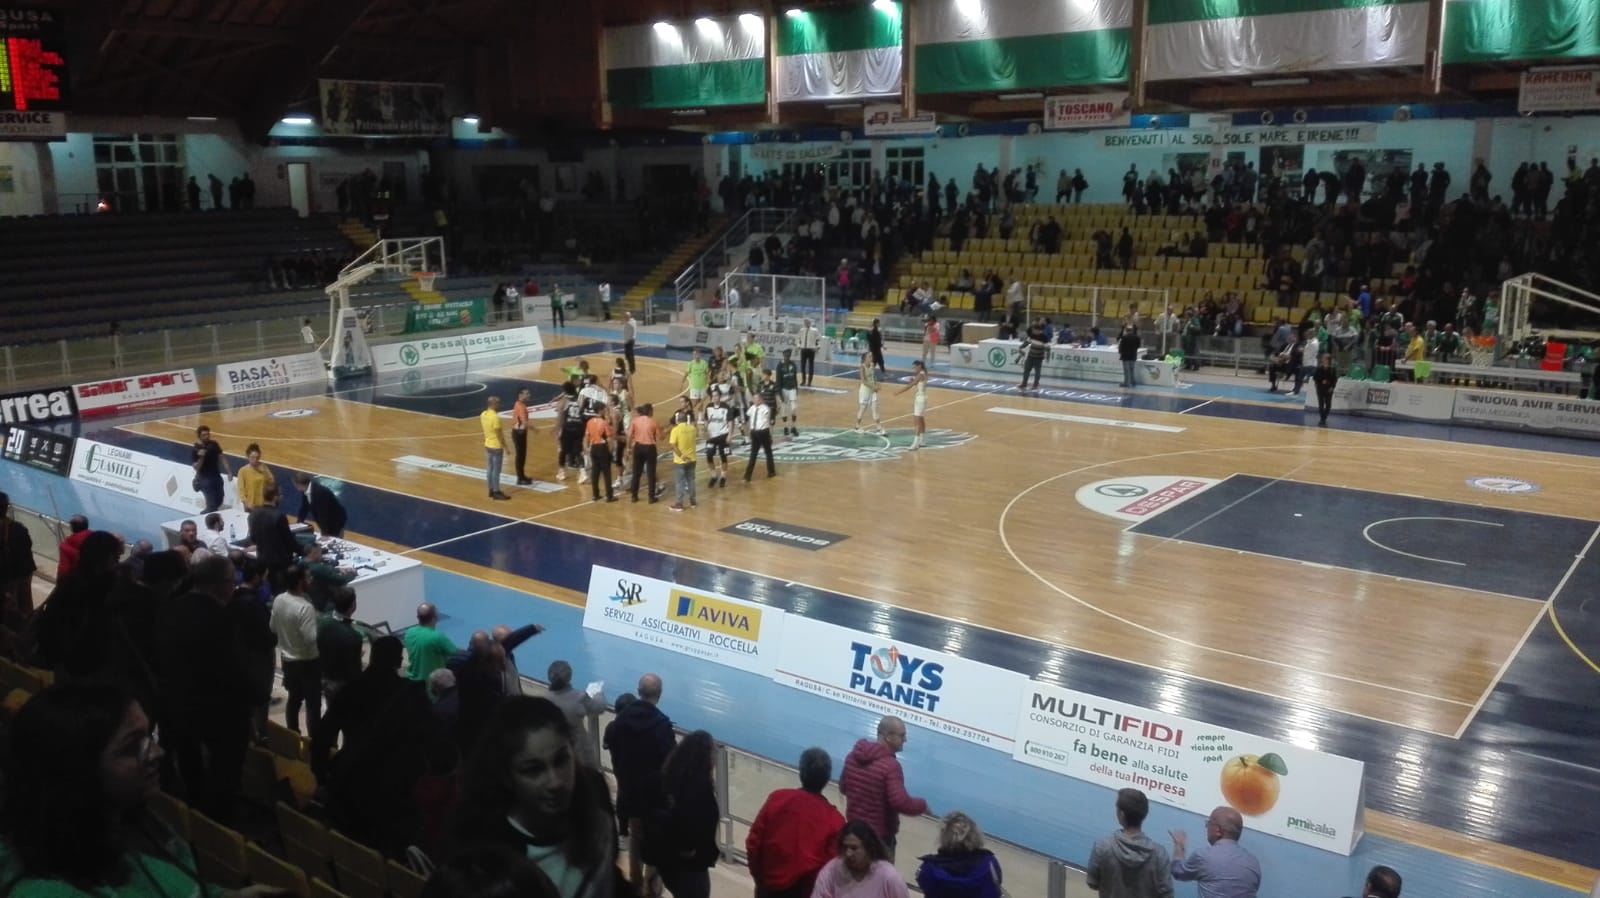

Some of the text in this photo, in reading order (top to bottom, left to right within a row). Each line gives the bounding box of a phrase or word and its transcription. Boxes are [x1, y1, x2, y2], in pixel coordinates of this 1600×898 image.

[1526, 72, 1592, 84] KAMERINA
[1059, 102, 1113, 115] TOSCANO
[1104, 134, 1164, 146] BENVENUTI
[1172, 134, 1184, 145] AL
[422, 334, 506, 351] Passalacqua
[1010, 348, 1099, 364] Placqua
[232, 377, 290, 391] FITNESS CLUB
[1474, 396, 1518, 406] NUOVA
[1522, 398, 1553, 410] AVIR
[1124, 480, 1202, 516] DESPAR
[604, 607, 758, 656] SERVIZI ASSICURATIVI ROCCELLA
[698, 606, 750, 632] AVIVA
[634, 632, 664, 644] RAGUSA
[850, 640, 944, 692] TOYS
[850, 672, 940, 712] PLANET
[842, 692, 867, 704] Vittorio
[929, 719, 941, 728] Tel.
[1032, 692, 1183, 746] MULTIFIDI
[1030, 712, 1179, 759] CONSORZIO DI GARANZIA FIDI
[1030, 746, 1041, 754] 800
[1073, 738, 1188, 781] fa bene alla salute
[1090, 762, 1186, 797] della tua Impresa
